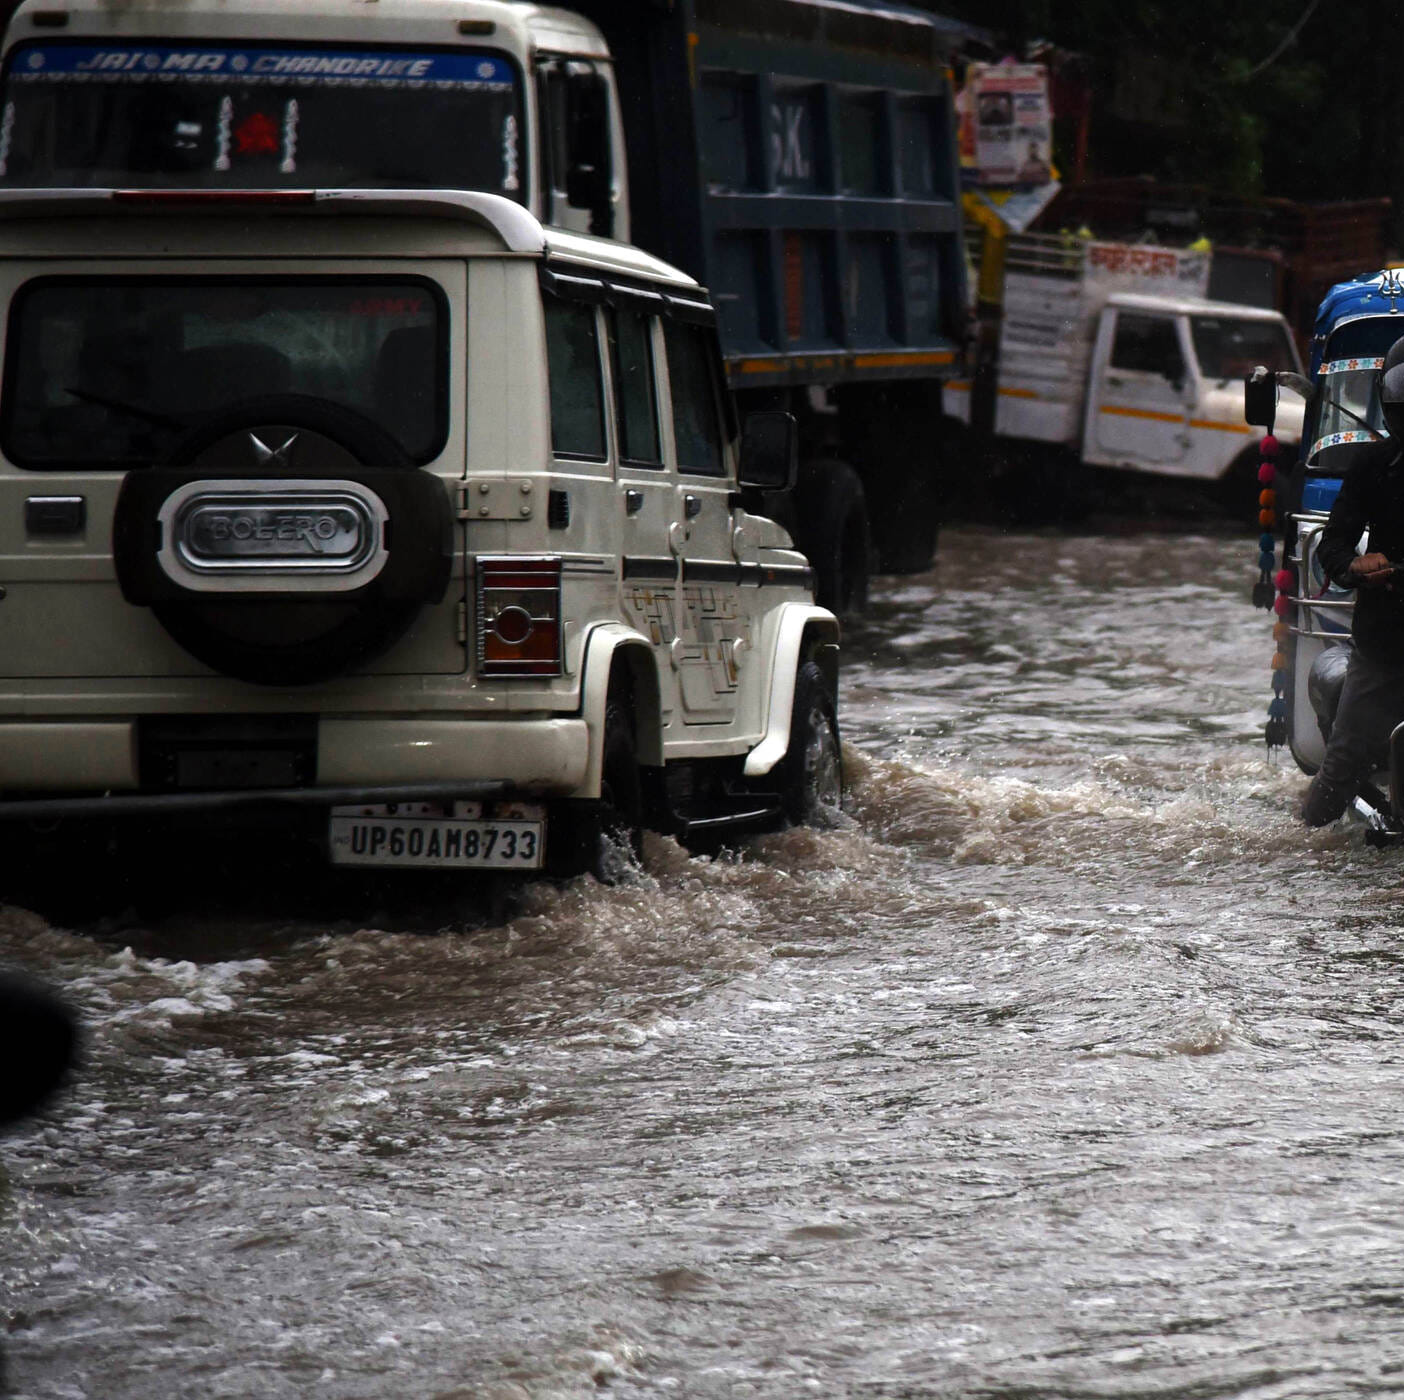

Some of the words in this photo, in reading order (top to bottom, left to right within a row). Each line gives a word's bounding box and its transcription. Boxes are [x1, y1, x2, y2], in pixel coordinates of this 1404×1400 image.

[77, 53, 144, 70] JAI
[161, 54, 226, 70] MA
[253, 56, 434, 76] CHANDRIKE
[210, 515, 338, 552] BOLERO
[351, 825, 536, 859] UP60AM8733
